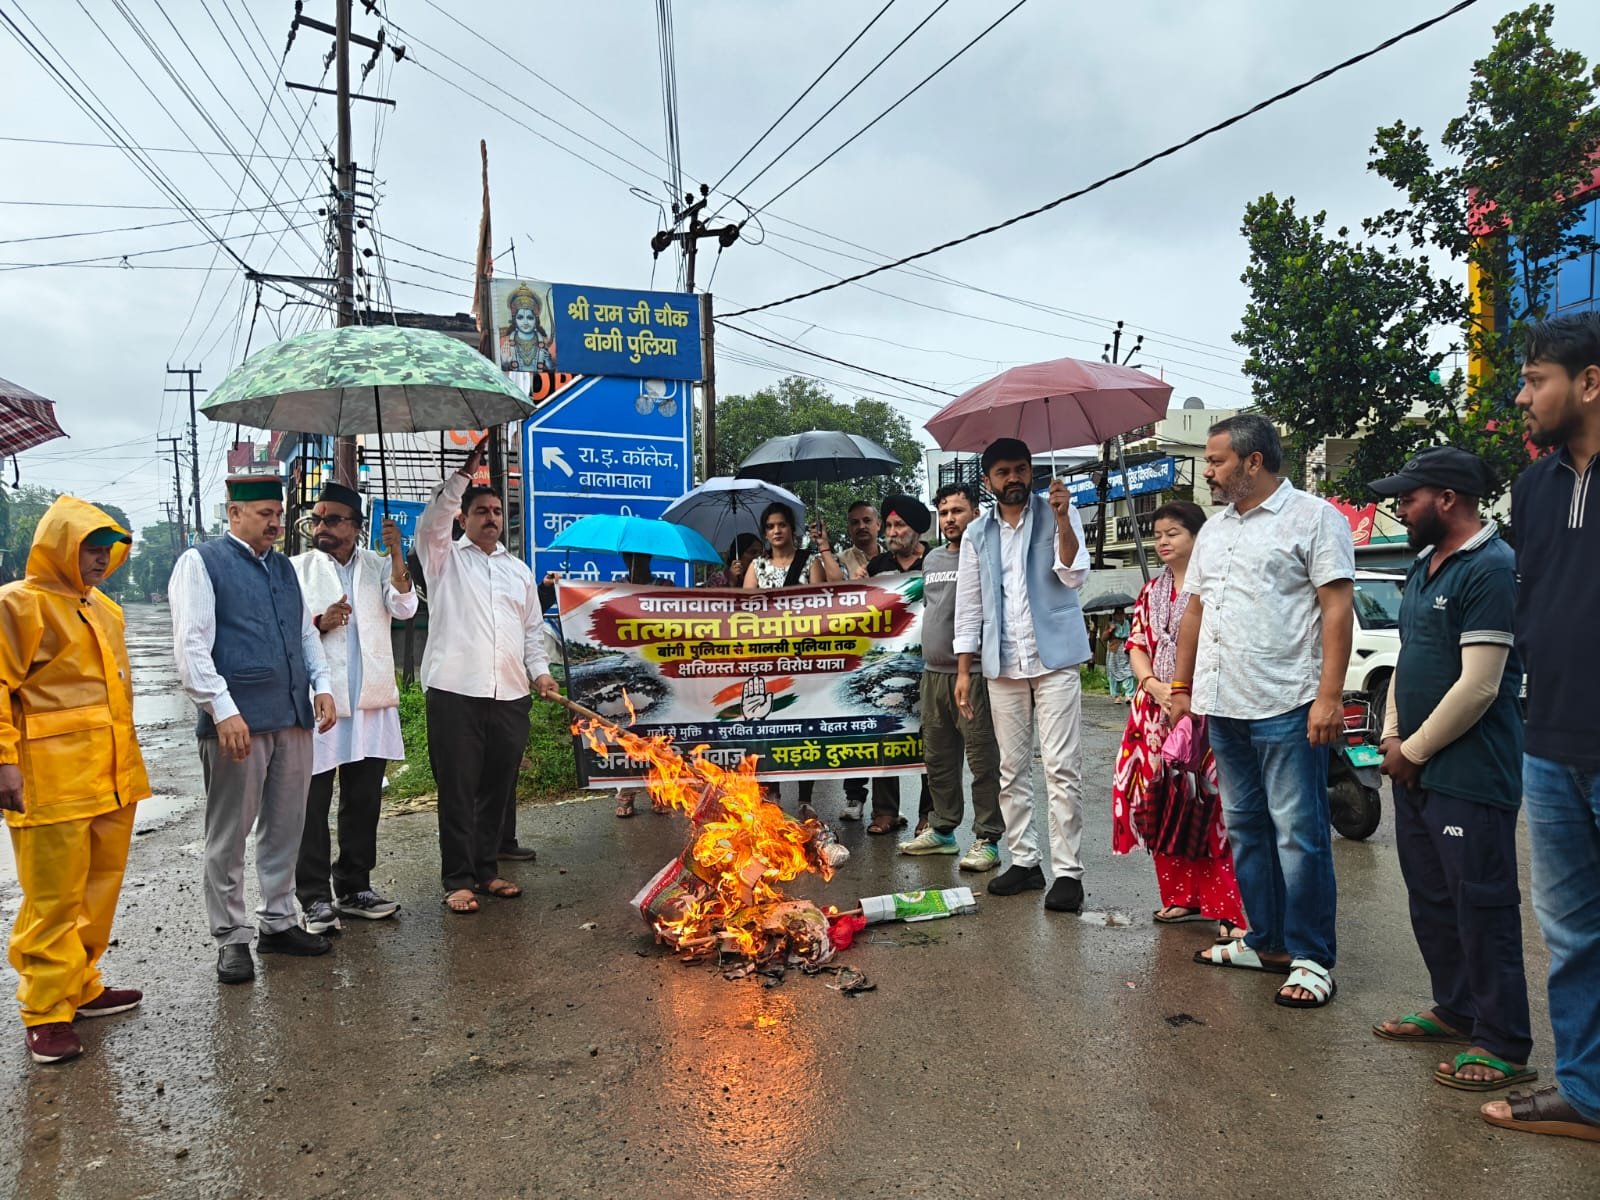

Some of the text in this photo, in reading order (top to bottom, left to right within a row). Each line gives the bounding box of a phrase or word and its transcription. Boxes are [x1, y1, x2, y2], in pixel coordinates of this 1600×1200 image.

[567, 295, 689, 327] श्री राम जी चौक
[584, 327, 677, 364] बांगी पुलिया
[622, 445, 679, 470] कॉलेज,
[578, 472, 652, 489] बालावाला
[638, 587, 868, 614] बालावाला की सड़कों का
[615, 605, 893, 641] तत्काल निर्माण करो!
[656, 638, 857, 660] बांगी पुलिया से मालसी पुलिया तक
[678, 656, 845, 675] क्षतिग्रस्त सड़क विरोध यात्रा
[718, 723, 753, 739] सुरक्षित
[756, 723, 802, 735] आवागमन
[850, 717, 878, 732] सड़कें
[770, 740, 821, 768] सड़कें
[882, 736, 924, 757] करो!
